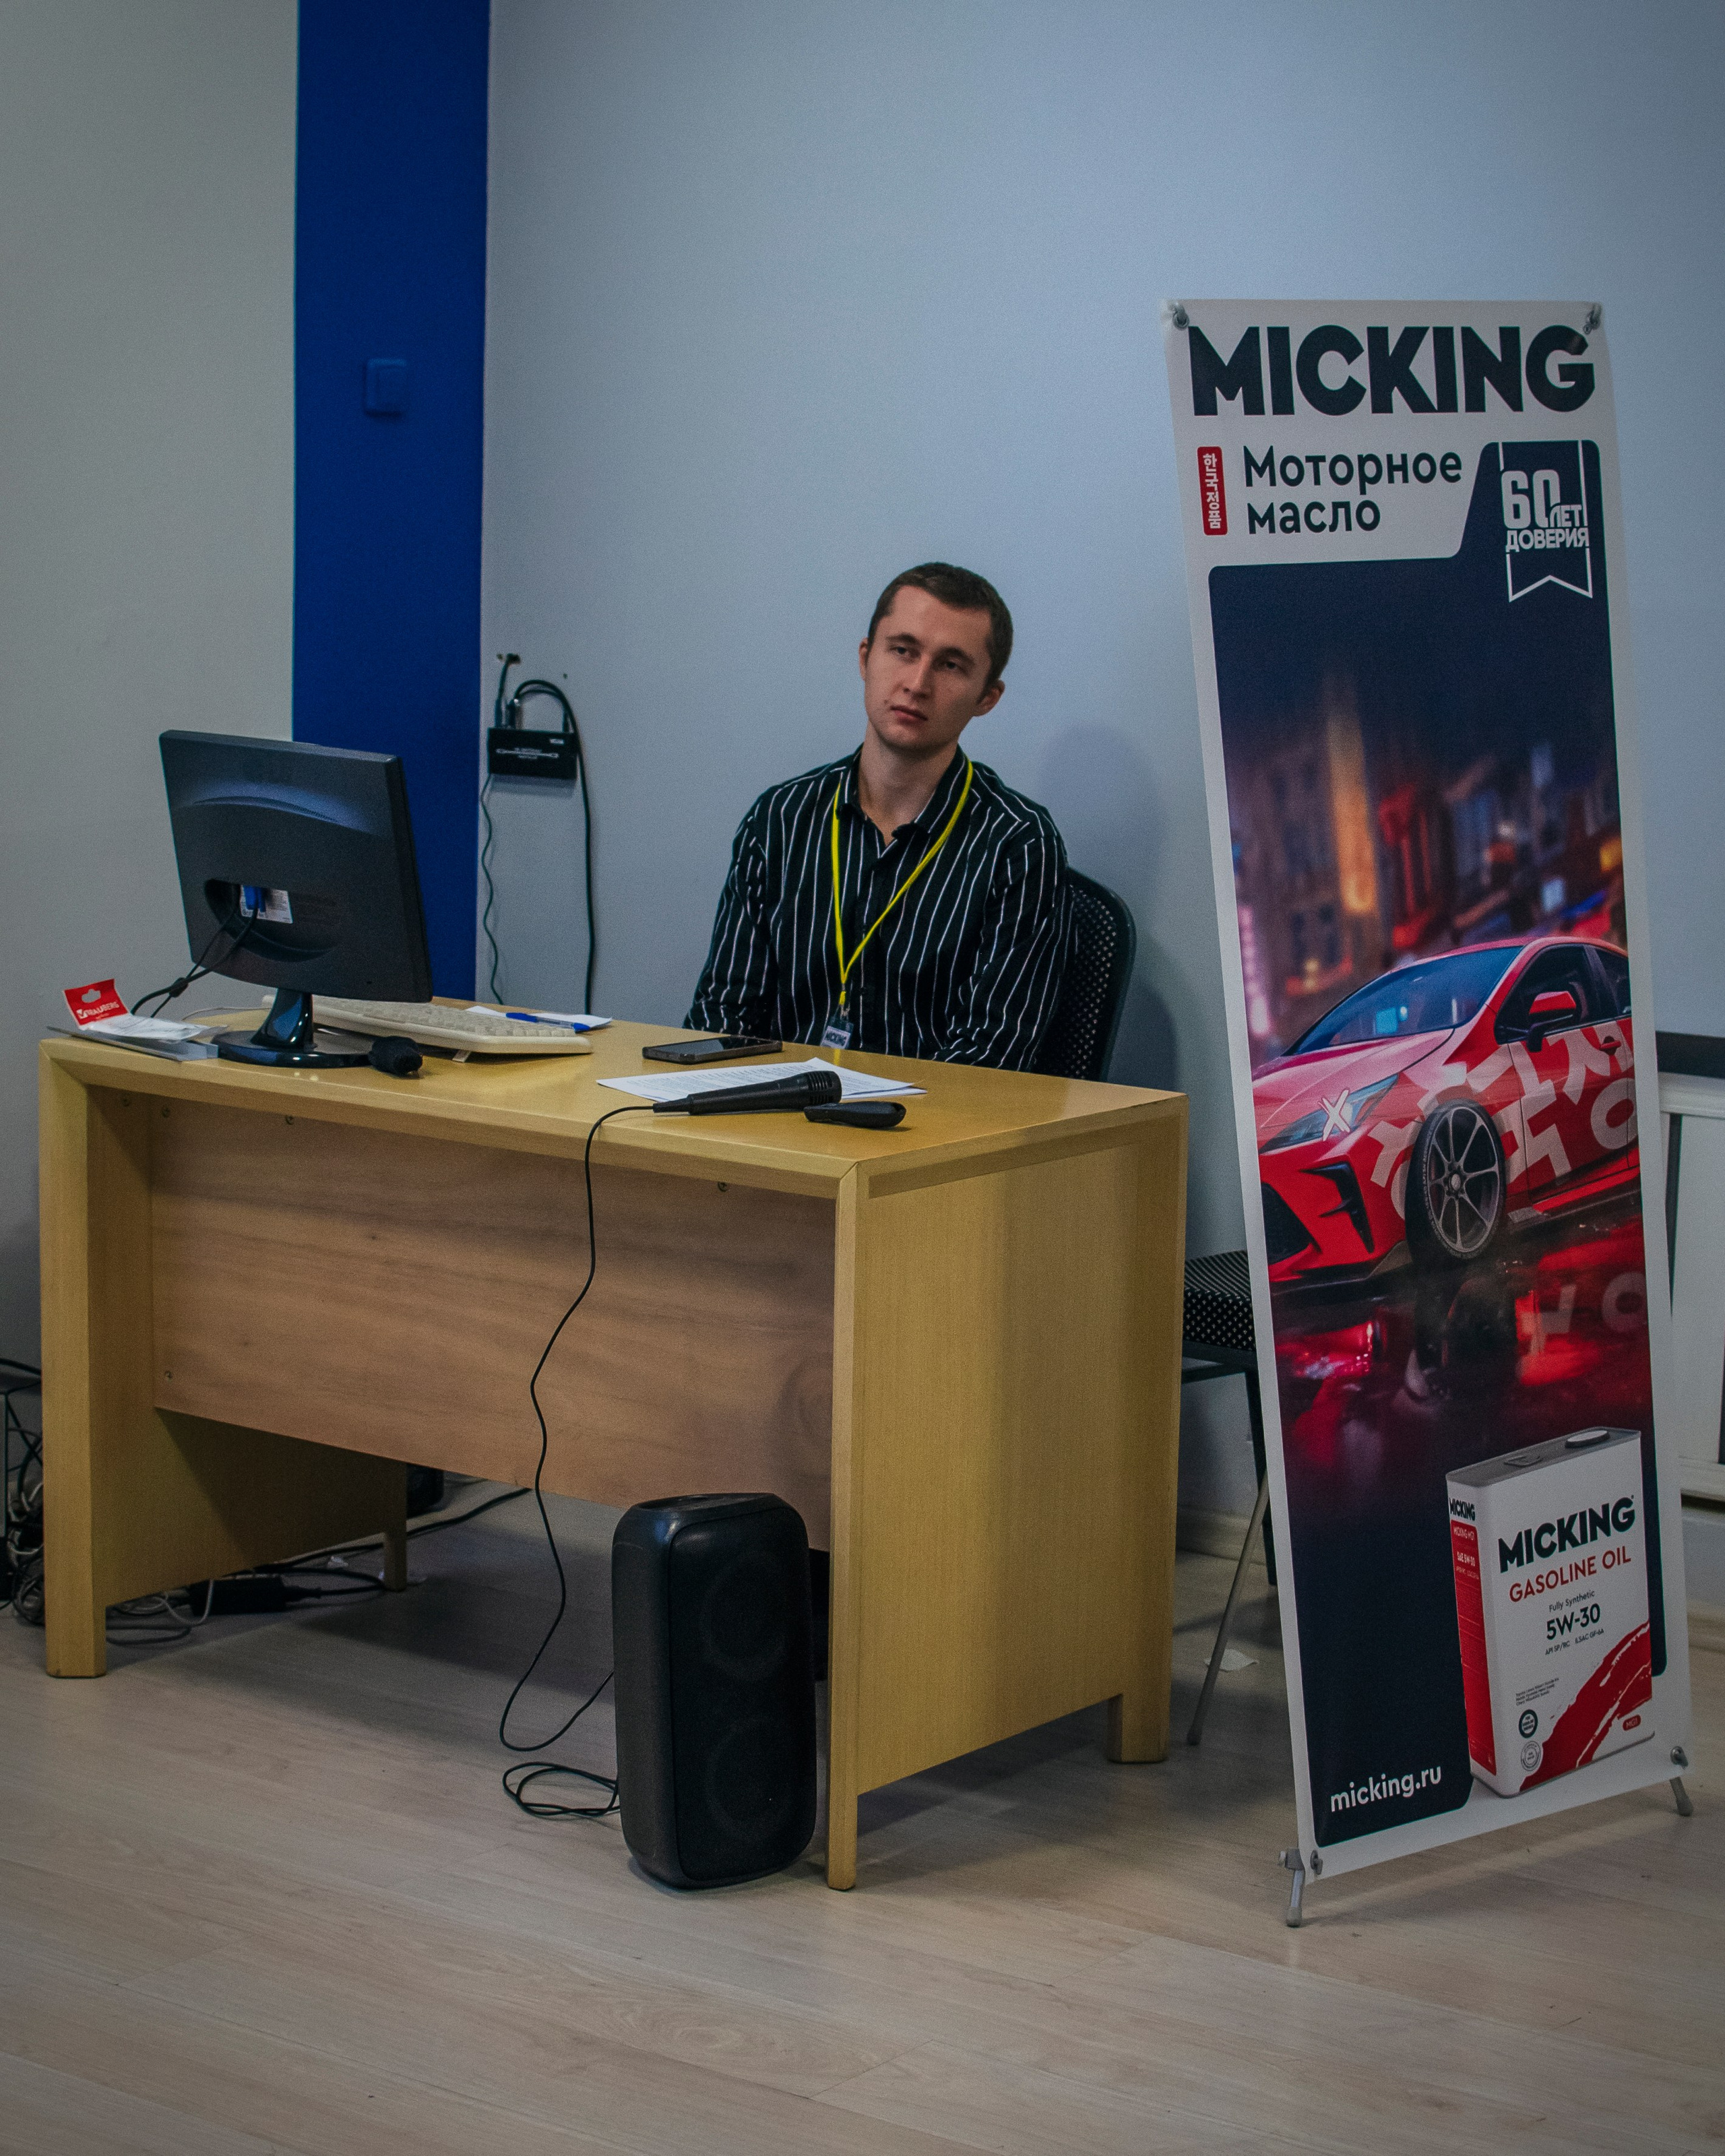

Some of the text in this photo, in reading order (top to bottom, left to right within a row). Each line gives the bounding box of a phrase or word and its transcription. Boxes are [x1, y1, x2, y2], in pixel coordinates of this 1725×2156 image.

[1187, 325, 1595, 416] MICKING
[1202, 453, 1222, 529] 한국정품
[1243, 445, 1462, 495] Моторное
[1247, 500, 1381, 534] масло
[1501, 470, 1582, 529] 60 ЛЕТ
[1505, 528, 1590, 552] ДОВЕРИЯ
[1449, 1498, 1476, 1521] MICKING
[1498, 1497, 1635, 1573] MICKING
[1509, 1556, 1597, 1602] GASOLINE
[1602, 1546, 1631, 1569] OIL
[1546, 1603, 1600, 1640] 5W-30
[1549, 1590, 1595, 1612] Fully Synthetic
[1330, 1766, 1442, 1812] micking.ru
